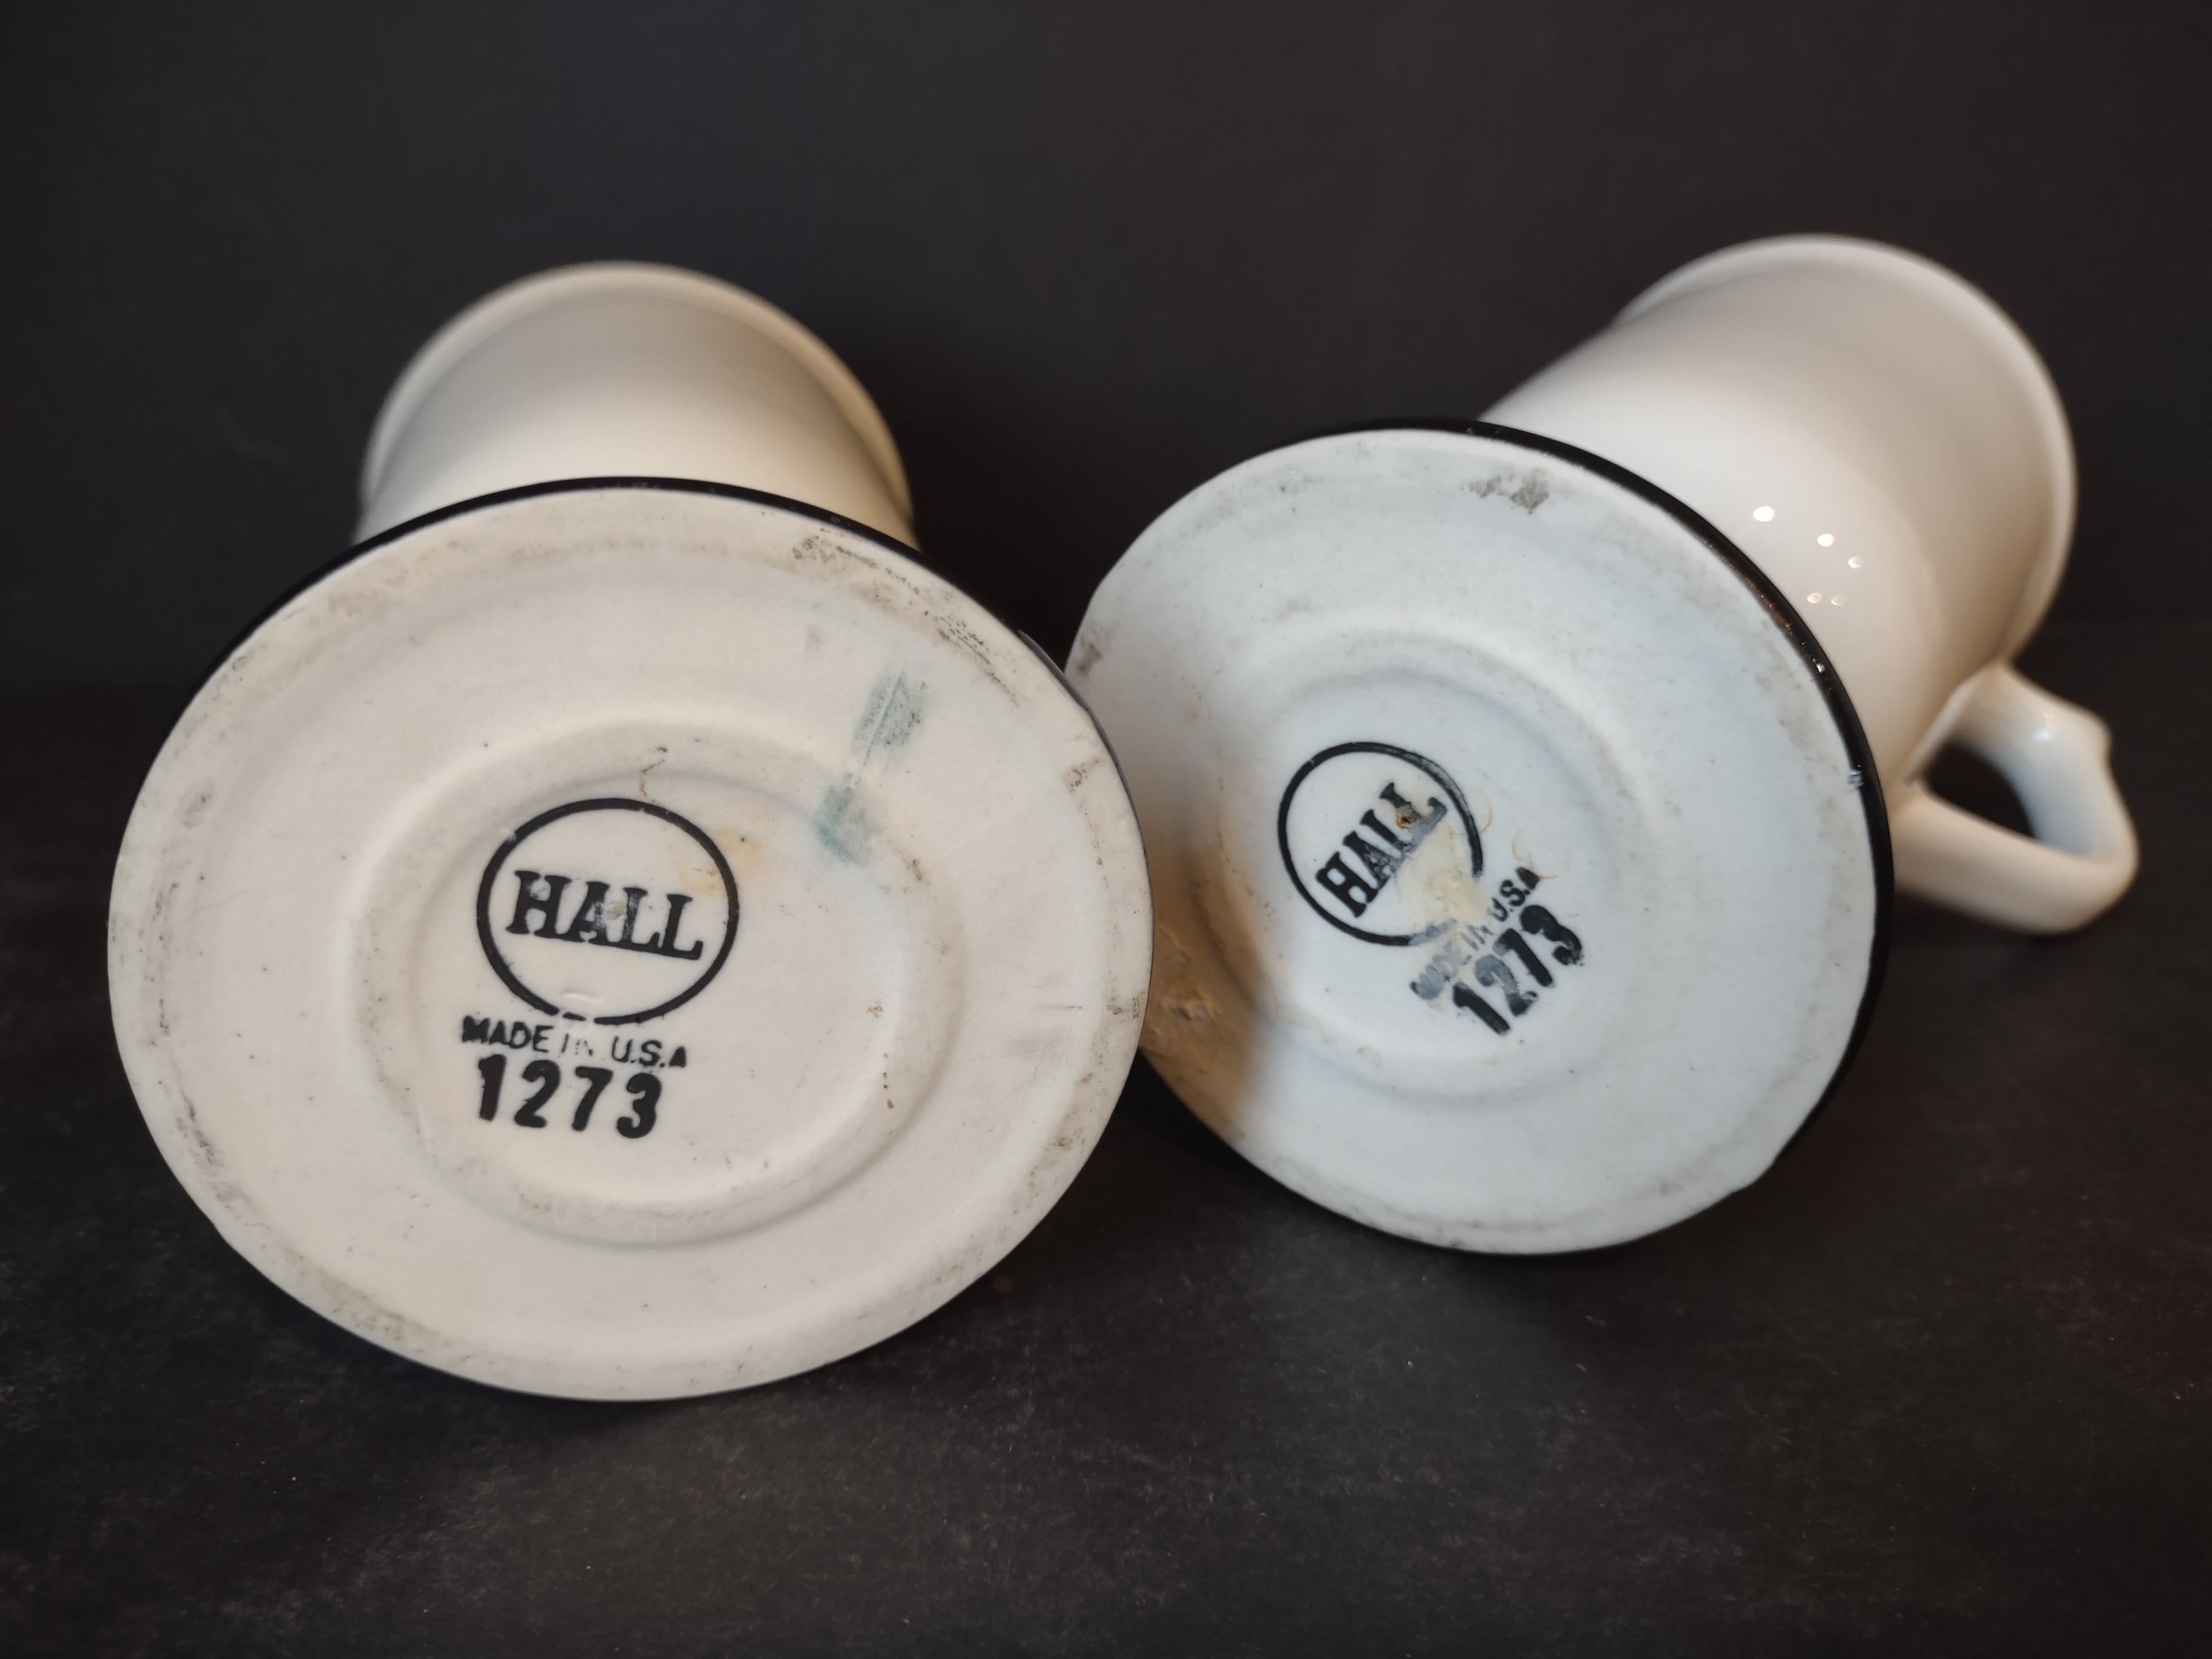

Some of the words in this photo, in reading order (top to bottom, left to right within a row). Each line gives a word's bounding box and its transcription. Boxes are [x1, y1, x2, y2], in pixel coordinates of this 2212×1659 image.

[1316, 782, 1448, 918] HALL
[506, 870, 703, 960] HALL
[1452, 904, 1582, 1036] 1273
[462, 1016, 555, 1052] MADE
[611, 1036, 688, 1068] U.S.A
[479, 1054, 662, 1139] 1273
